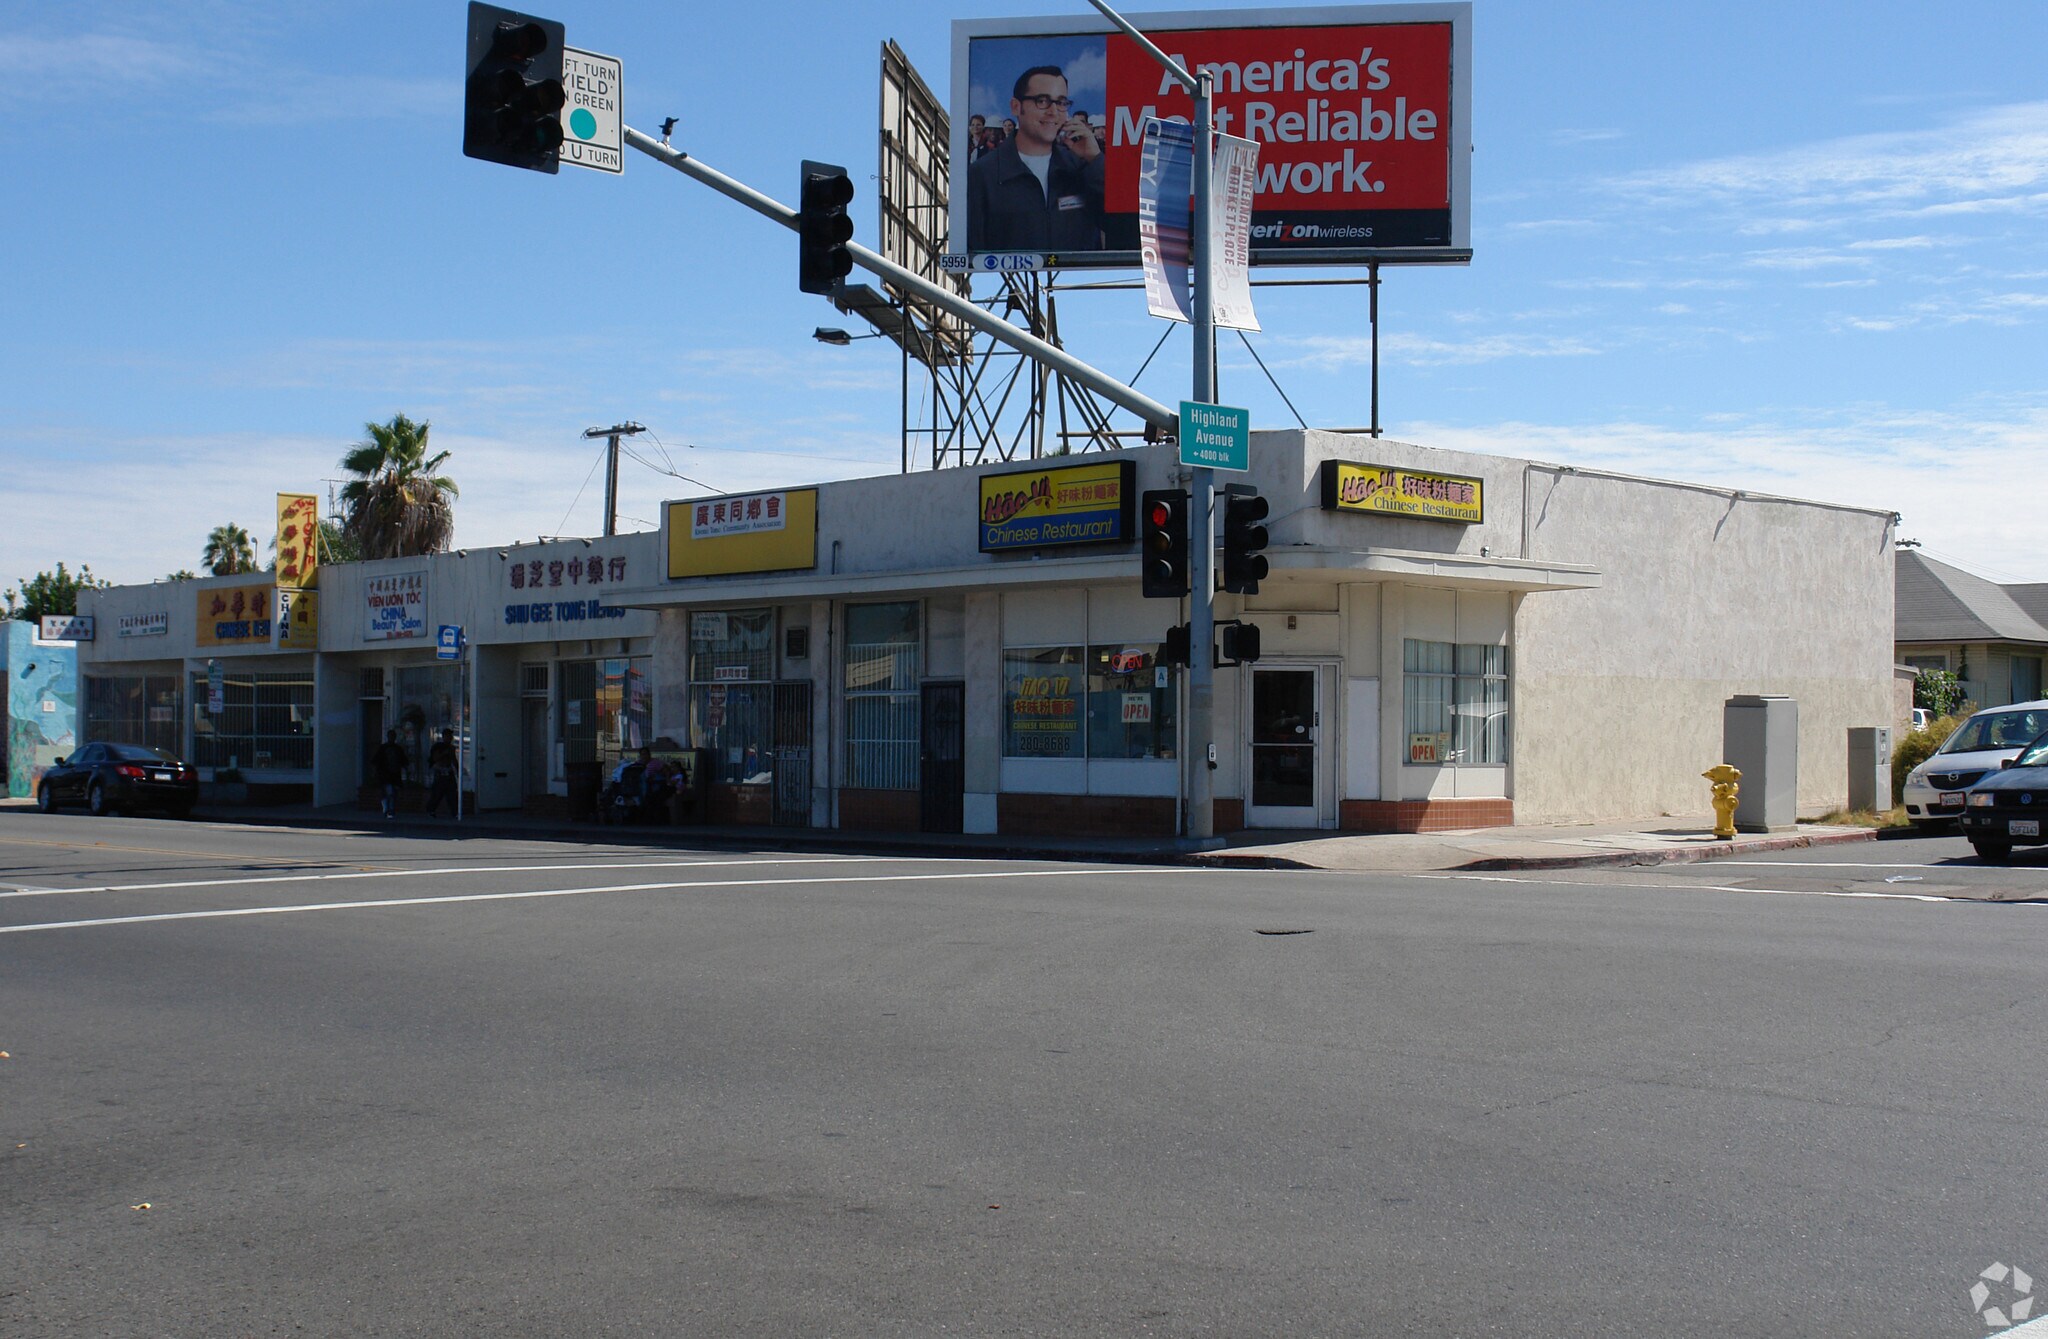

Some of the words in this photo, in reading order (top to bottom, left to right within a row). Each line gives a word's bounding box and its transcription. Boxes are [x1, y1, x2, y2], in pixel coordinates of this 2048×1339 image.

[565, 58, 578, 72] FT
[584, 62, 615, 81] TURN
[1158, 47, 1391, 95] America's
[562, 73, 608, 95] YIELD
[574, 92, 613, 111] GREEN
[1112, 105, 1233, 147] Mt
[1245, 96, 1437, 143] Reliable
[571, 143, 582, 159] U
[588, 149, 618, 166] TURN
[1140, 121, 1162, 186] CITY
[1254, 149, 1385, 193] work.
[1225, 165, 1241, 266] MARKETPLACE
[1237, 168, 1254, 267] INTERNATIONAL
[942, 256, 967, 268] 5959
[1001, 255, 1033, 269] CBS
[1139, 198, 1163, 312] HEIGHT
[1191, 409, 1238, 428] Highland
[1196, 429, 1234, 447] Avenue
[1200, 449, 1217, 461] 4000
[1219, 452, 1229, 462] blk
[1057, 482, 1119, 504] 好味粉麵家
[1402, 475, 1476, 504] 好味粉麵家
[696, 496, 781, 526] 廣東同鄉會
[1373, 496, 1418, 512] Chinese
[1422, 503, 1478, 519] Restaurant
[987, 526, 1038, 544] Chinese
[1042, 518, 1113, 539] Restaurant
[280, 594, 290, 638] CHINA
[381, 606, 407, 620] CHINA
[505, 604, 529, 624] SHIU
[530, 603, 553, 623] GEE
[555, 601, 586, 621] TONG
[372, 619, 397, 632] Beauty
[401, 617, 421, 630] Salon
[1111, 653, 1143, 670] OPEN
[1157, 673, 1165, 681] A
[1124, 704, 1150, 719] OPEN
[1412, 744, 1435, 760] OPEN
